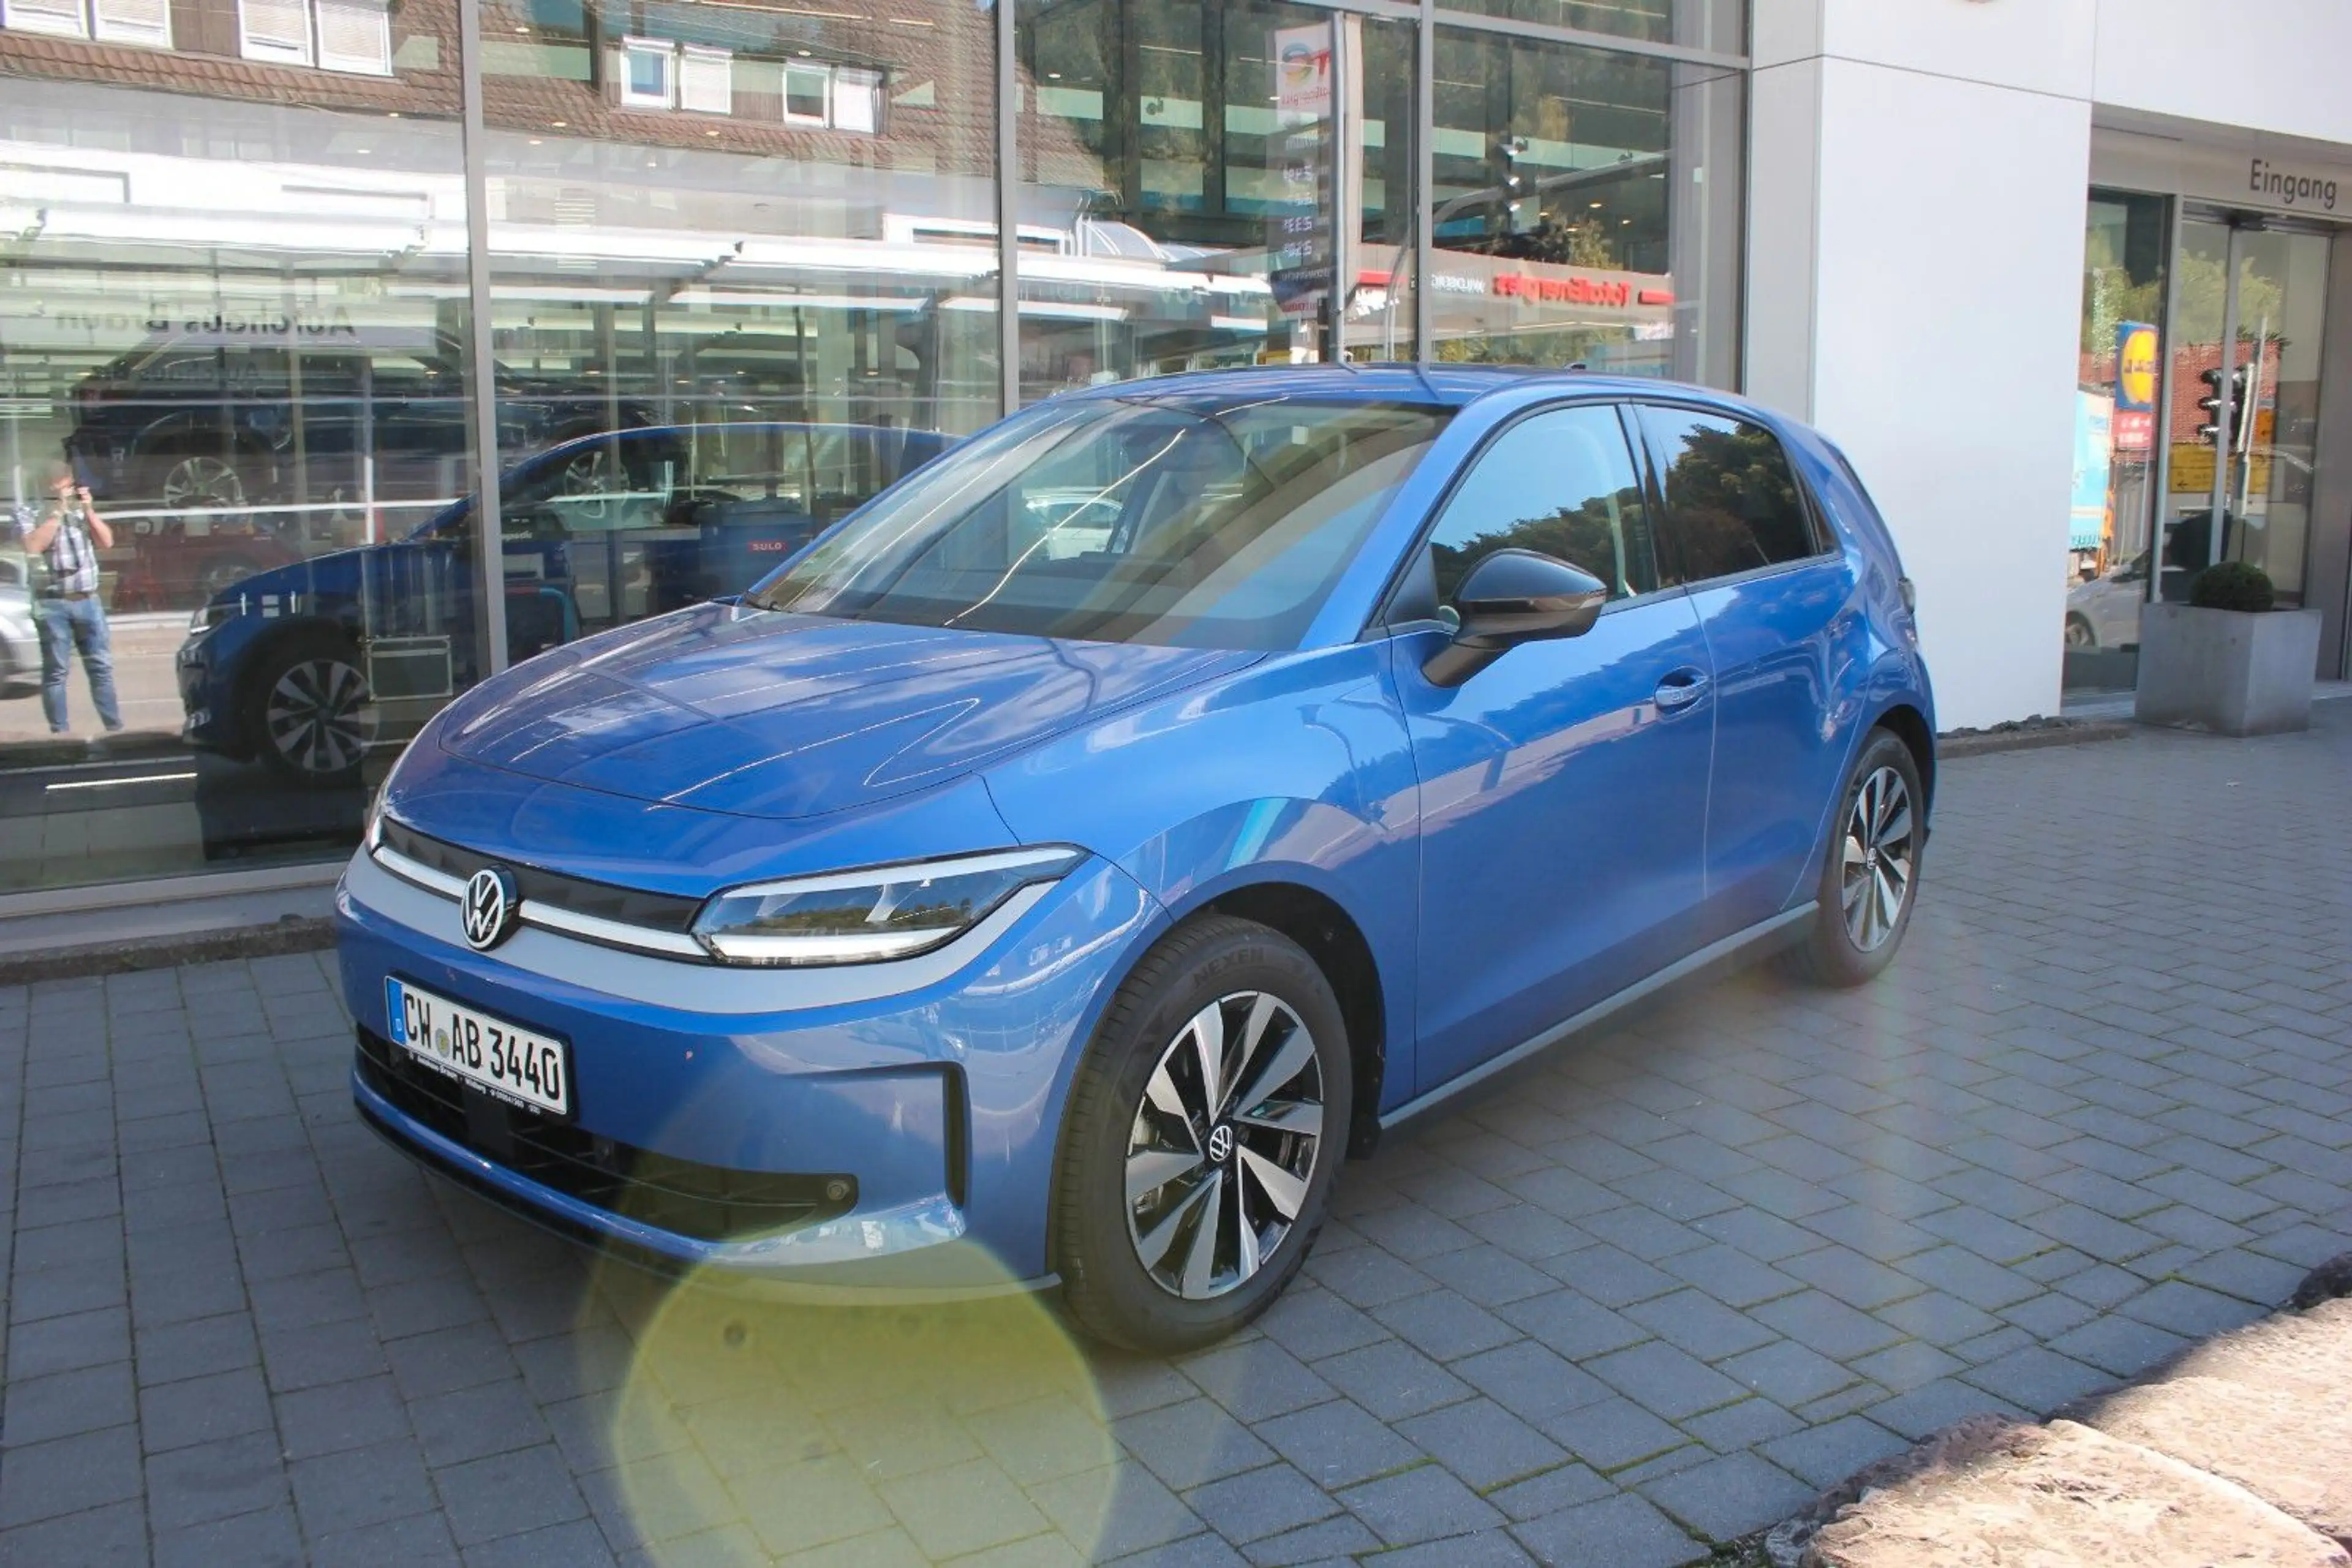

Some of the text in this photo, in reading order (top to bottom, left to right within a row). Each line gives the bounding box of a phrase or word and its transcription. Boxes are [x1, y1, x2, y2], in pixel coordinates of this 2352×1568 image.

[2250, 159, 2337, 209] Eingang
[752, 541, 783, 551] SULO
[1193, 947, 1265, 987] NEXEN
[404, 992, 431, 1050] CW
[452, 1013, 482, 1069] AB
[488, 1026, 560, 1101] 3440
